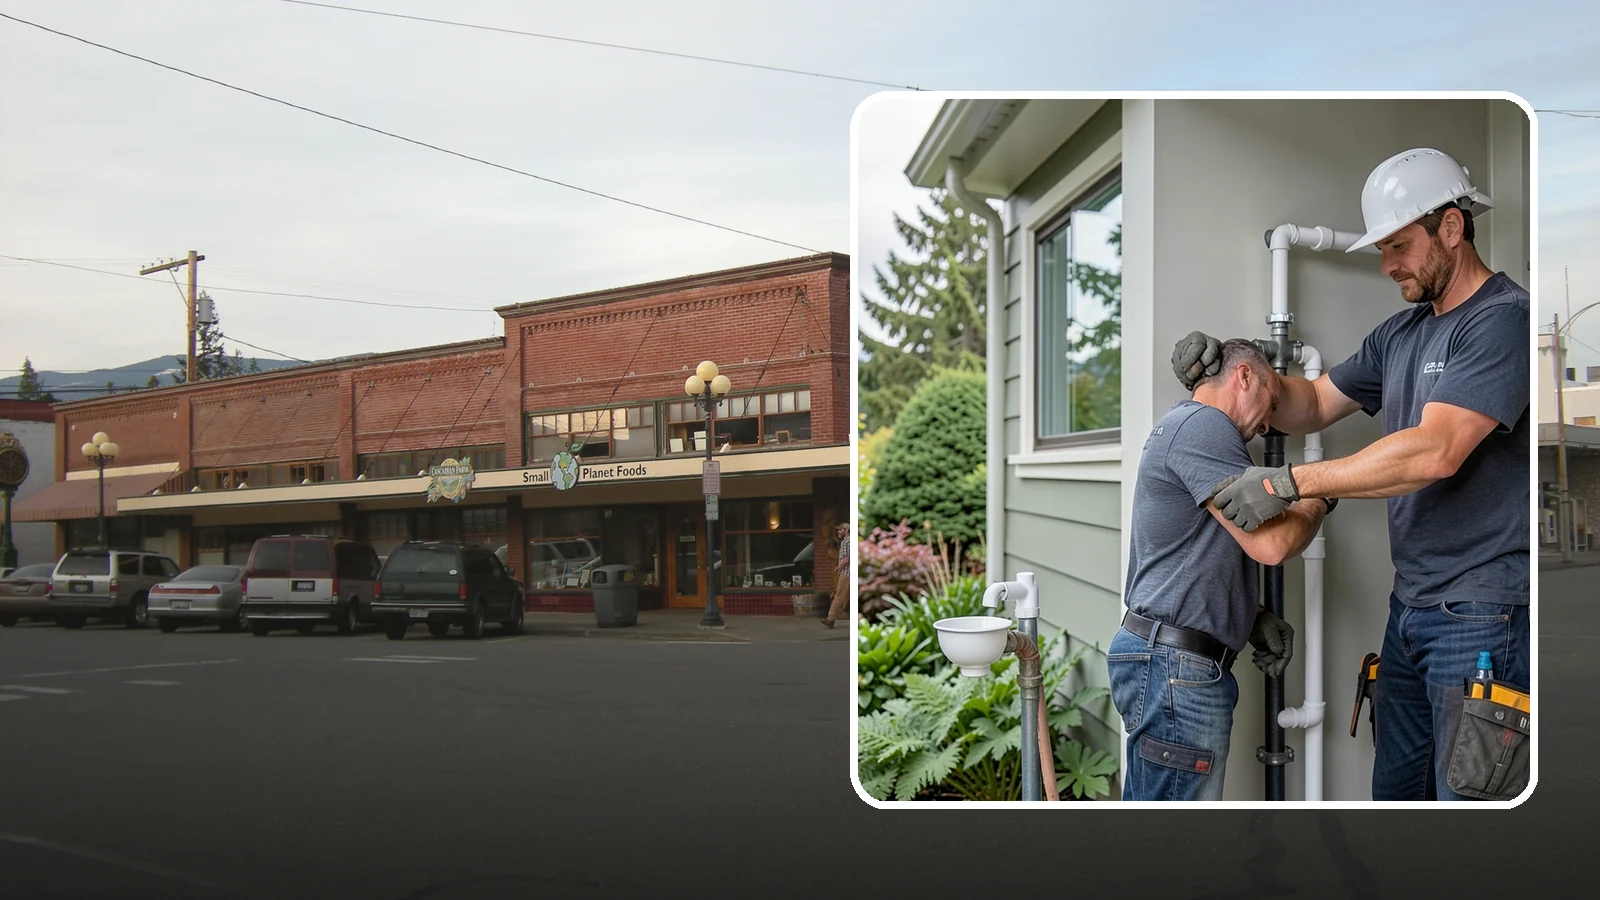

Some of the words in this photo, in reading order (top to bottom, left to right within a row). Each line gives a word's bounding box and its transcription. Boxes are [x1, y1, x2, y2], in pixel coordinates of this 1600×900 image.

[523, 471, 549, 483] Small
[583, 467, 614, 479] Planet
[617, 464, 647, 477] Foods
